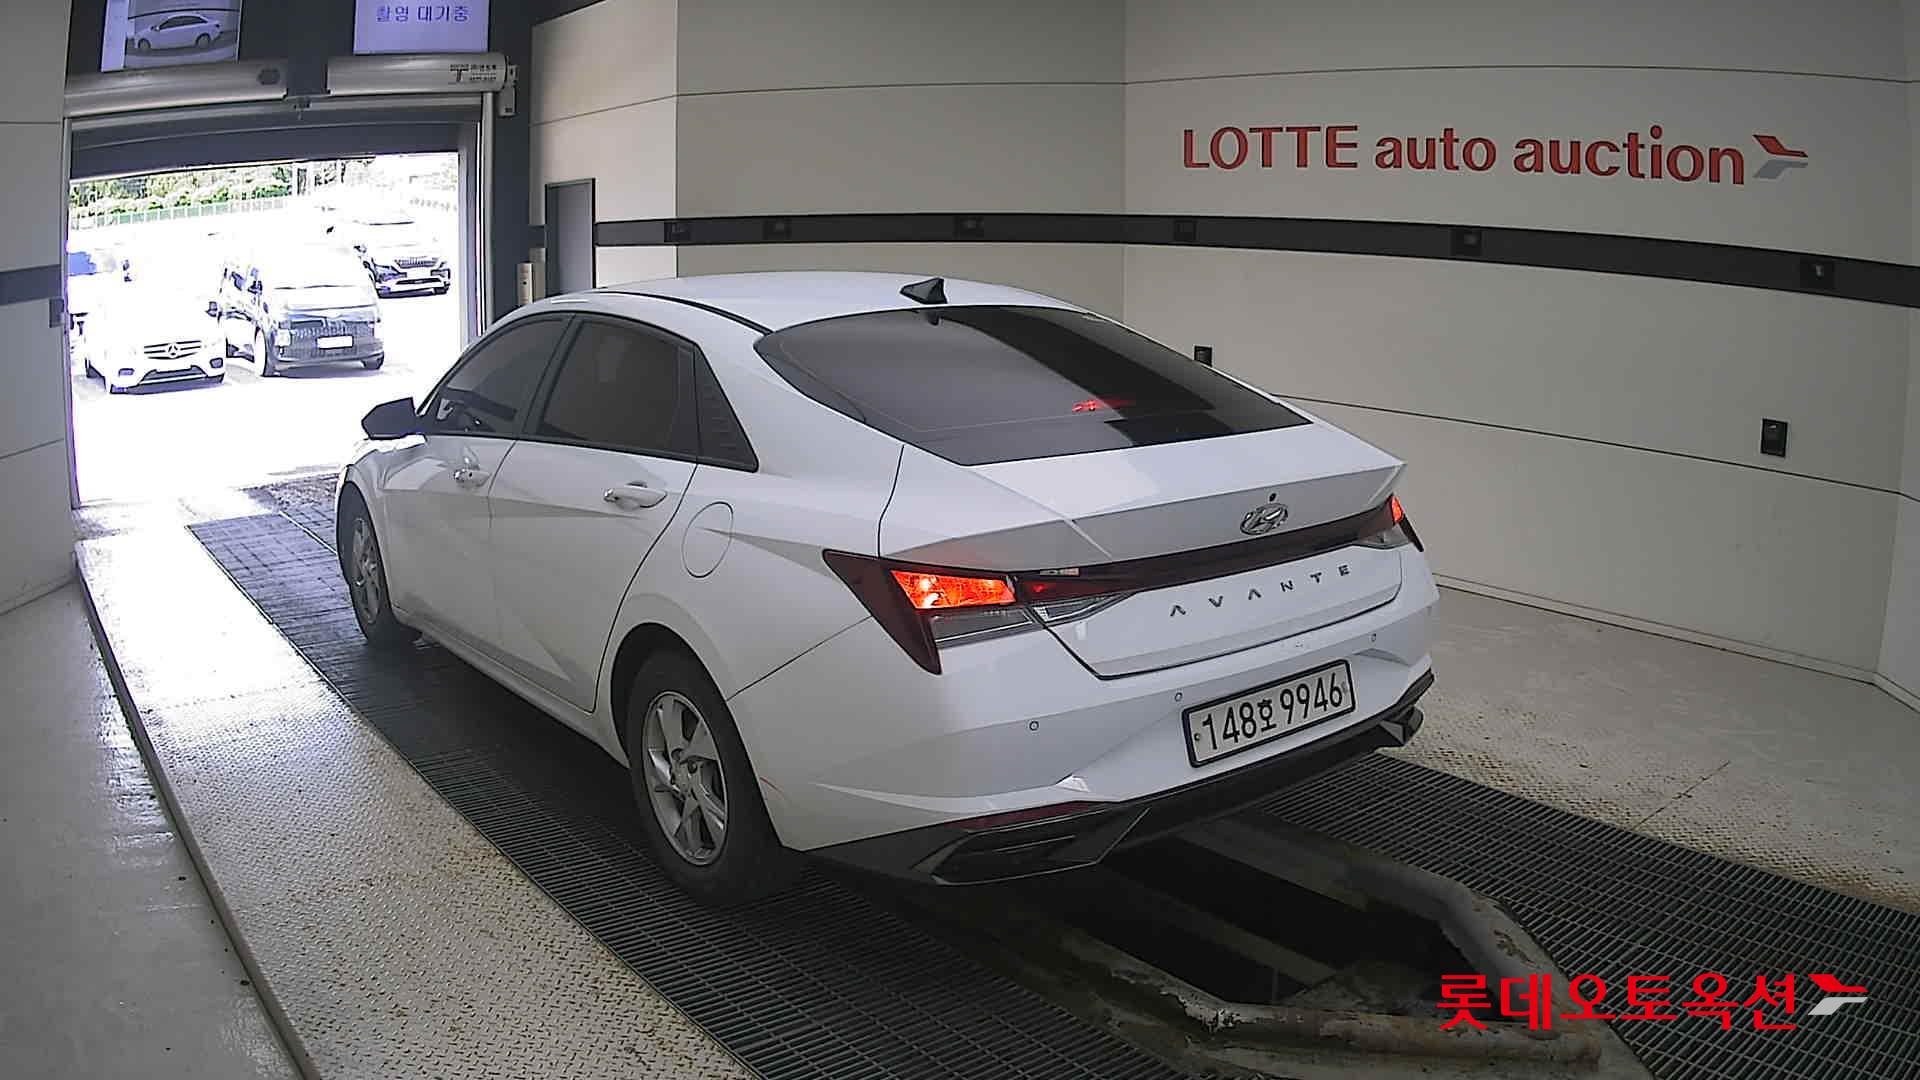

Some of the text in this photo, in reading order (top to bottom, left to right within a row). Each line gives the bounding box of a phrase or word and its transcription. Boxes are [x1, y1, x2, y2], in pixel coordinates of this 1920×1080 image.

[417, 5, 469, 22] 대기중
[1183, 125, 1746, 185] LOTTE auto auction
[1169, 564, 1350, 617] AVANTE
